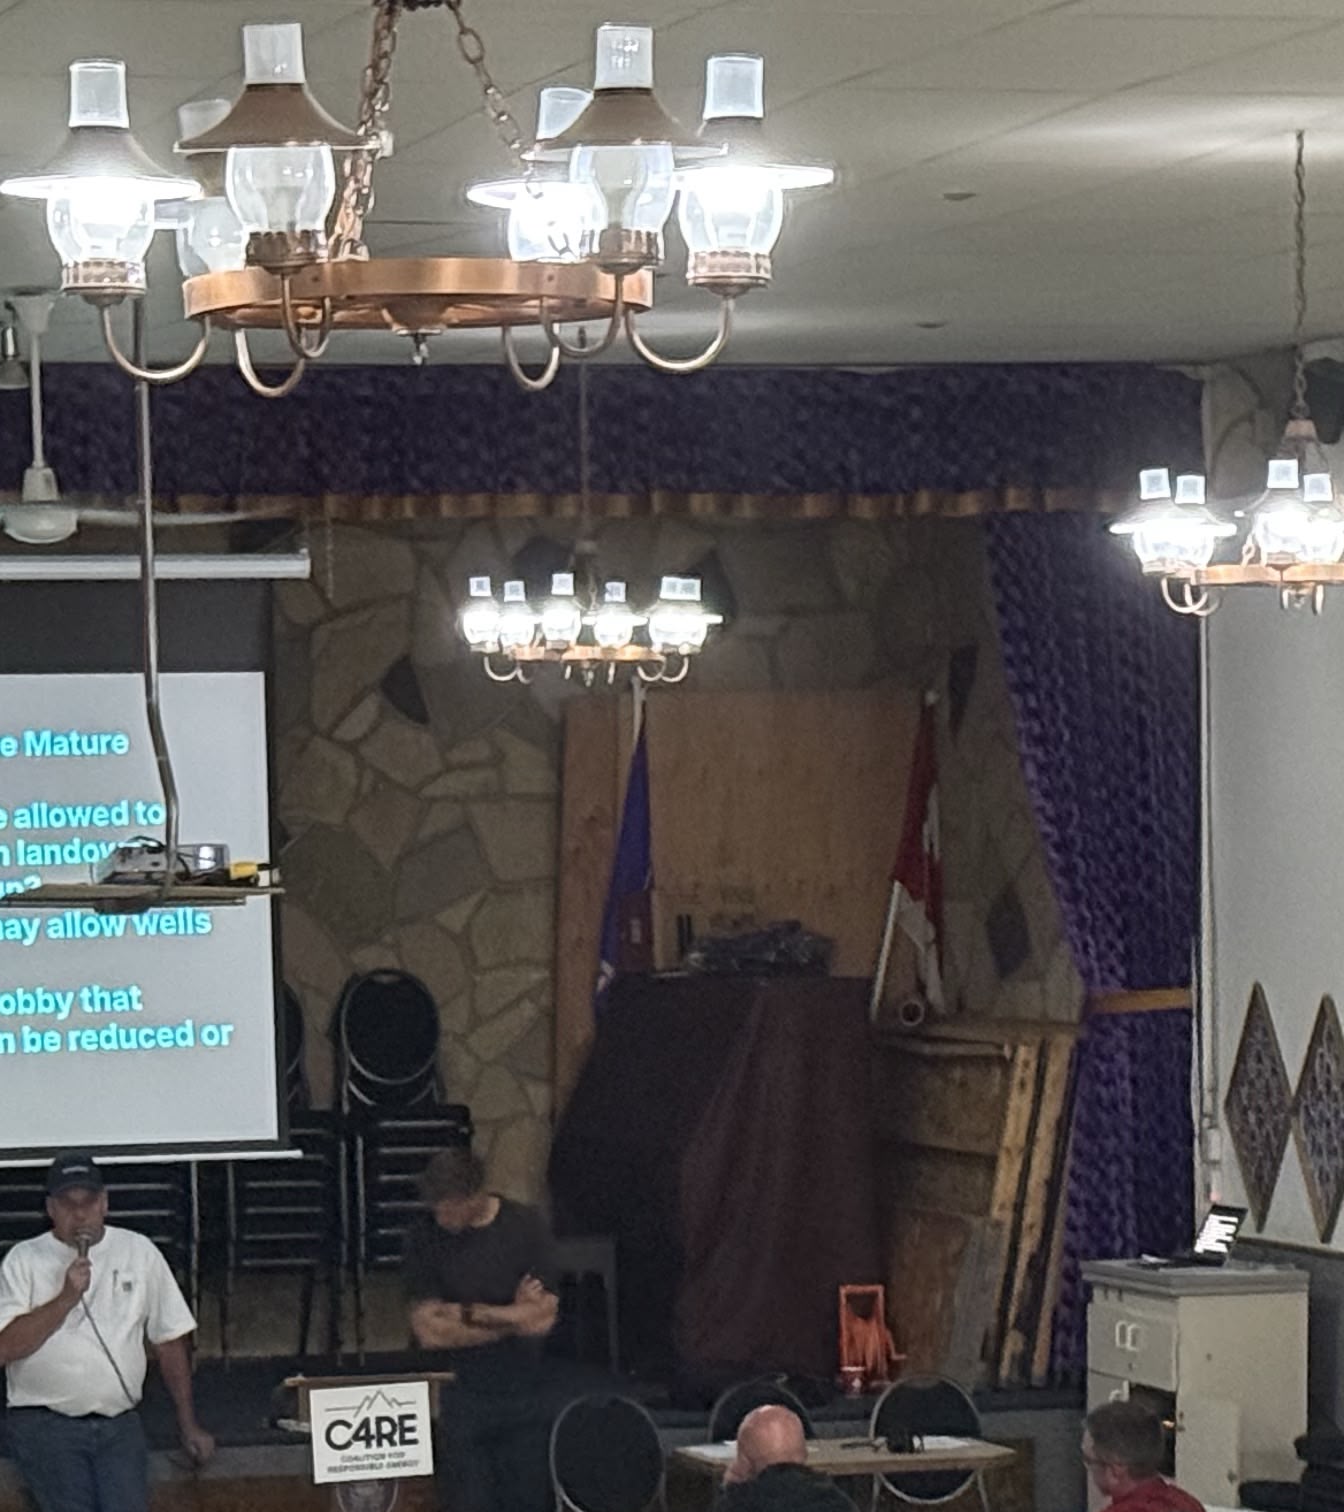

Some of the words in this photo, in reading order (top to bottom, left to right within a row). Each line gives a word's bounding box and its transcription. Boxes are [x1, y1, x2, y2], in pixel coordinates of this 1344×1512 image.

[22, 728, 129, 757] Mature
[10, 799, 130, 830] allowed
[132, 800, 165, 826] to
[43, 909, 128, 940] allow
[128, 906, 212, 936] wells
[76, 983, 141, 1014] that
[19, 1024, 63, 1055] be
[65, 1021, 196, 1053] reduced
[197, 1023, 232, 1047] or
